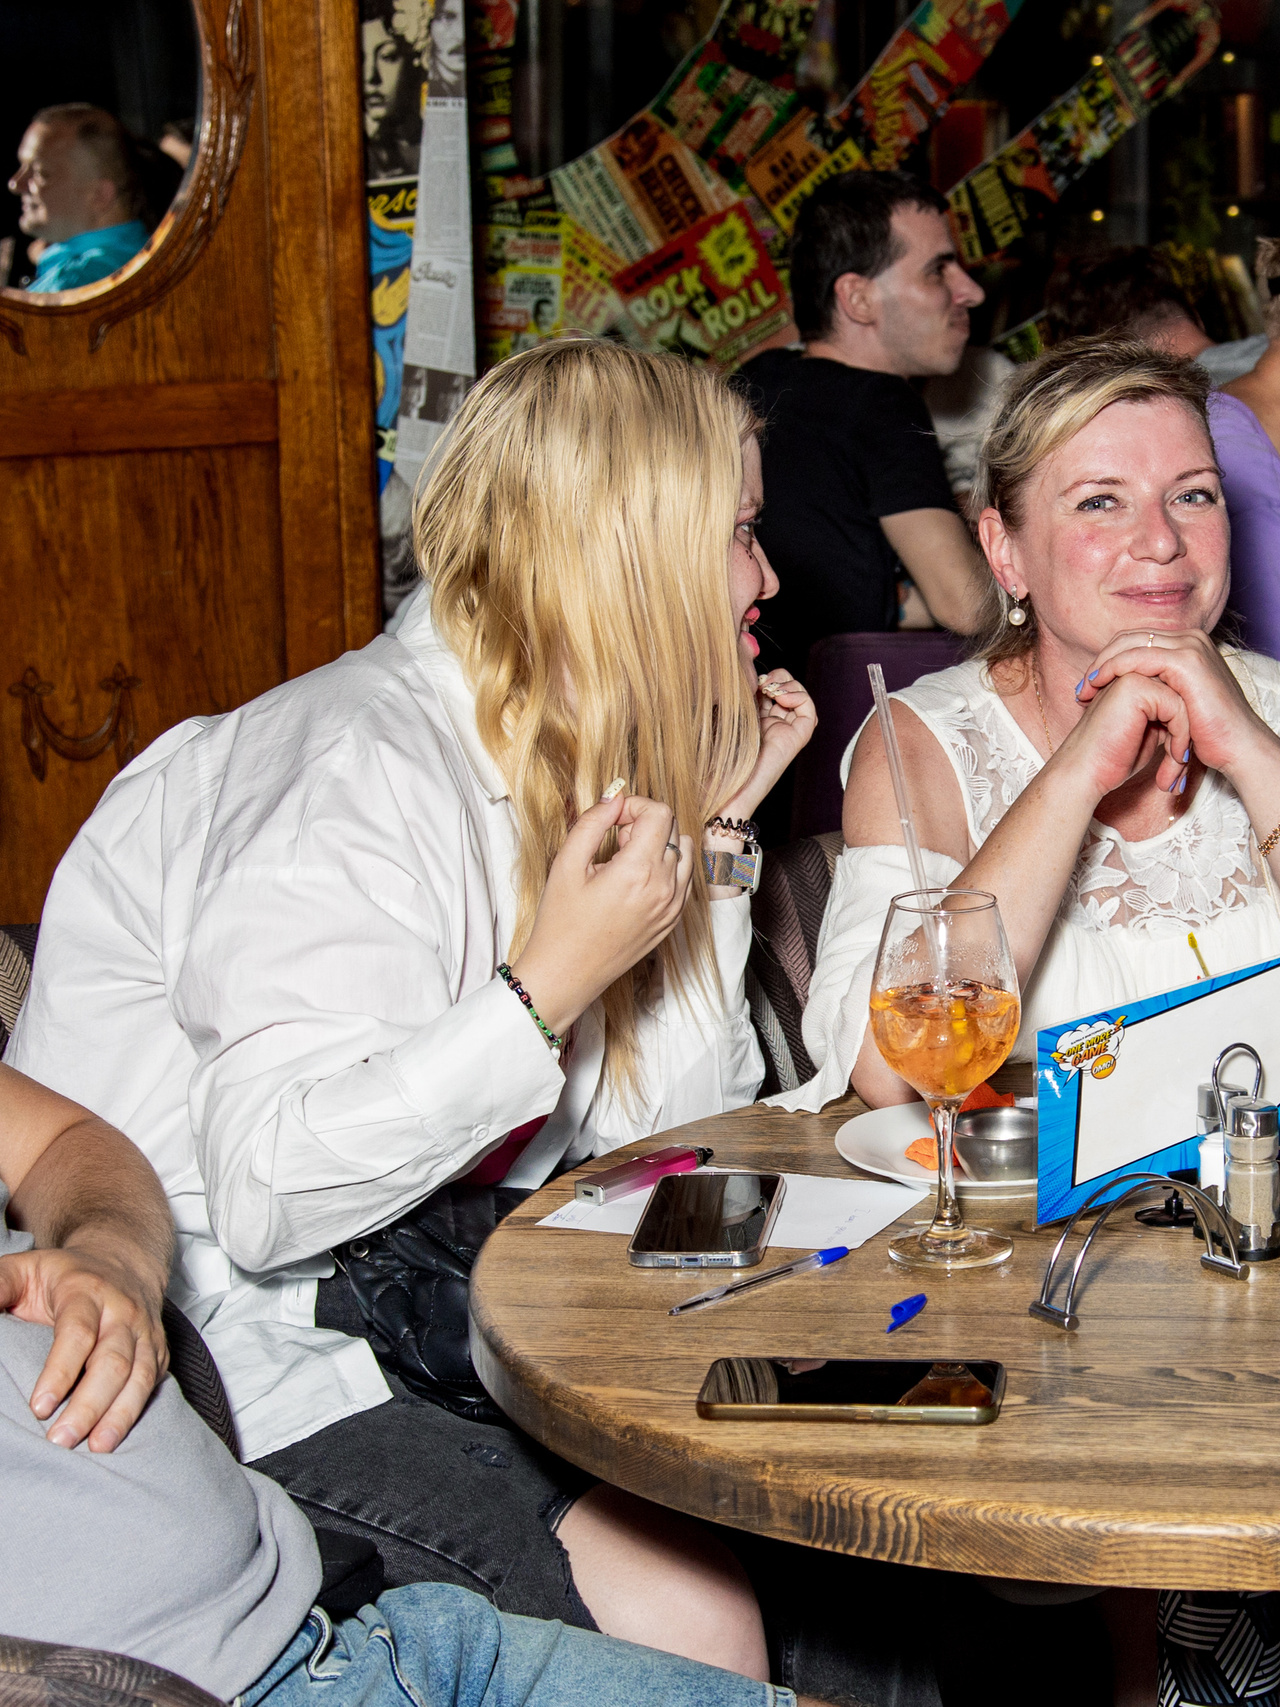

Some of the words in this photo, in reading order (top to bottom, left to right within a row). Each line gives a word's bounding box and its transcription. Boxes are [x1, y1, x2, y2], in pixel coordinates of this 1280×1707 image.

[638, 166, 688, 236] BERRY
[658, 153, 708, 223] CHUCK
[629, 265, 707, 329] ROCK
[701, 278, 780, 341] ROLL
[1065, 1042, 1085, 1057] ONE
[1084, 1029, 1114, 1049] MORE
[1071, 1040, 1111, 1067] GAME
[1093, 1058, 1115, 1075] OMG!
